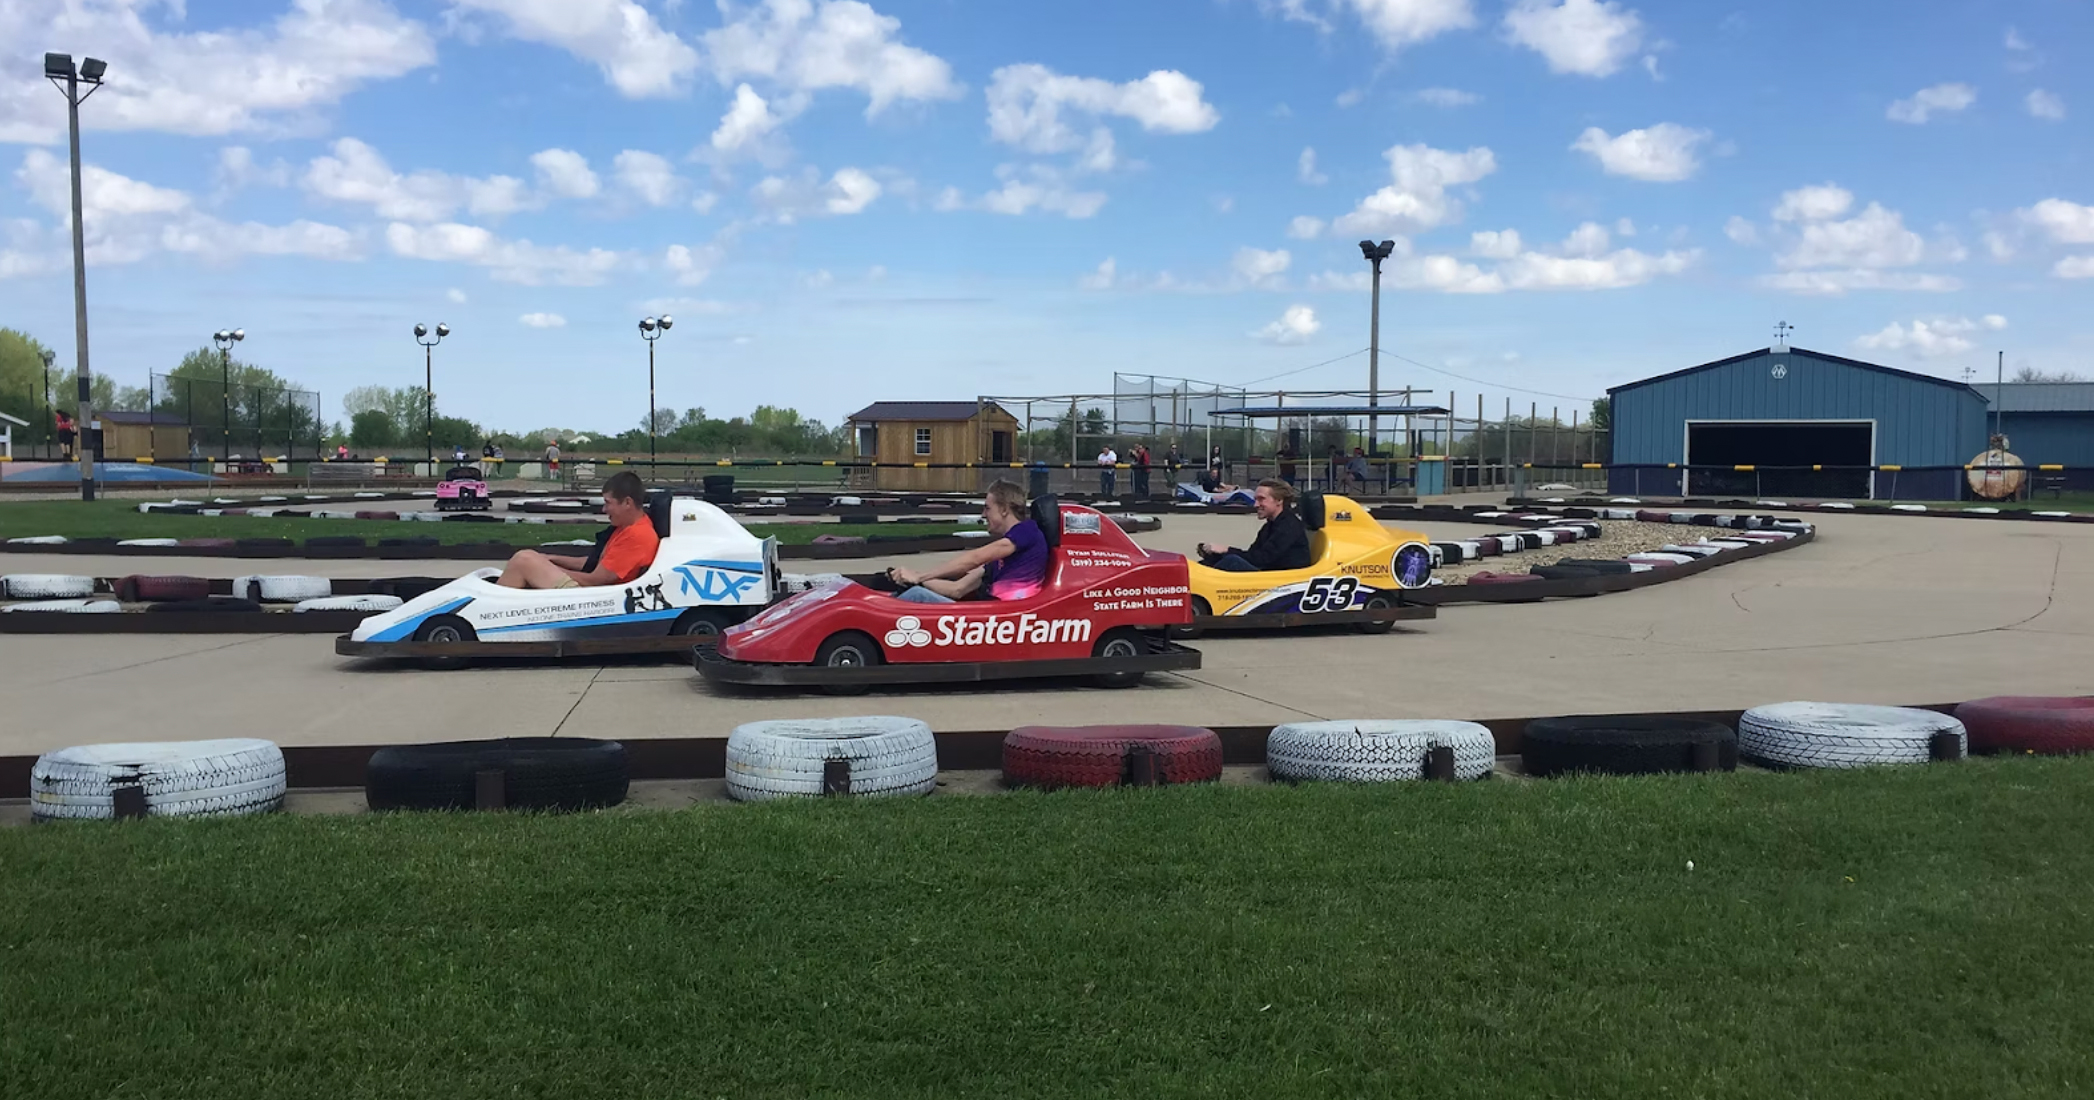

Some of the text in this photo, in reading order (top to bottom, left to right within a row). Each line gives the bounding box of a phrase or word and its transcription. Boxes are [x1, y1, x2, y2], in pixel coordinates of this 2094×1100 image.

[1341, 565, 1389, 574] KNUTSON
[1083, 589, 1103, 598] LIKE
[1105, 589, 1112, 597] A
[1114, 587, 1141, 596] GOOD
[1299, 575, 1361, 613] 53
[479, 599, 616, 621] NEXT LEVEL EXTREME FITNESS
[1094, 598, 1184, 611] STATE FARM IS THERE
